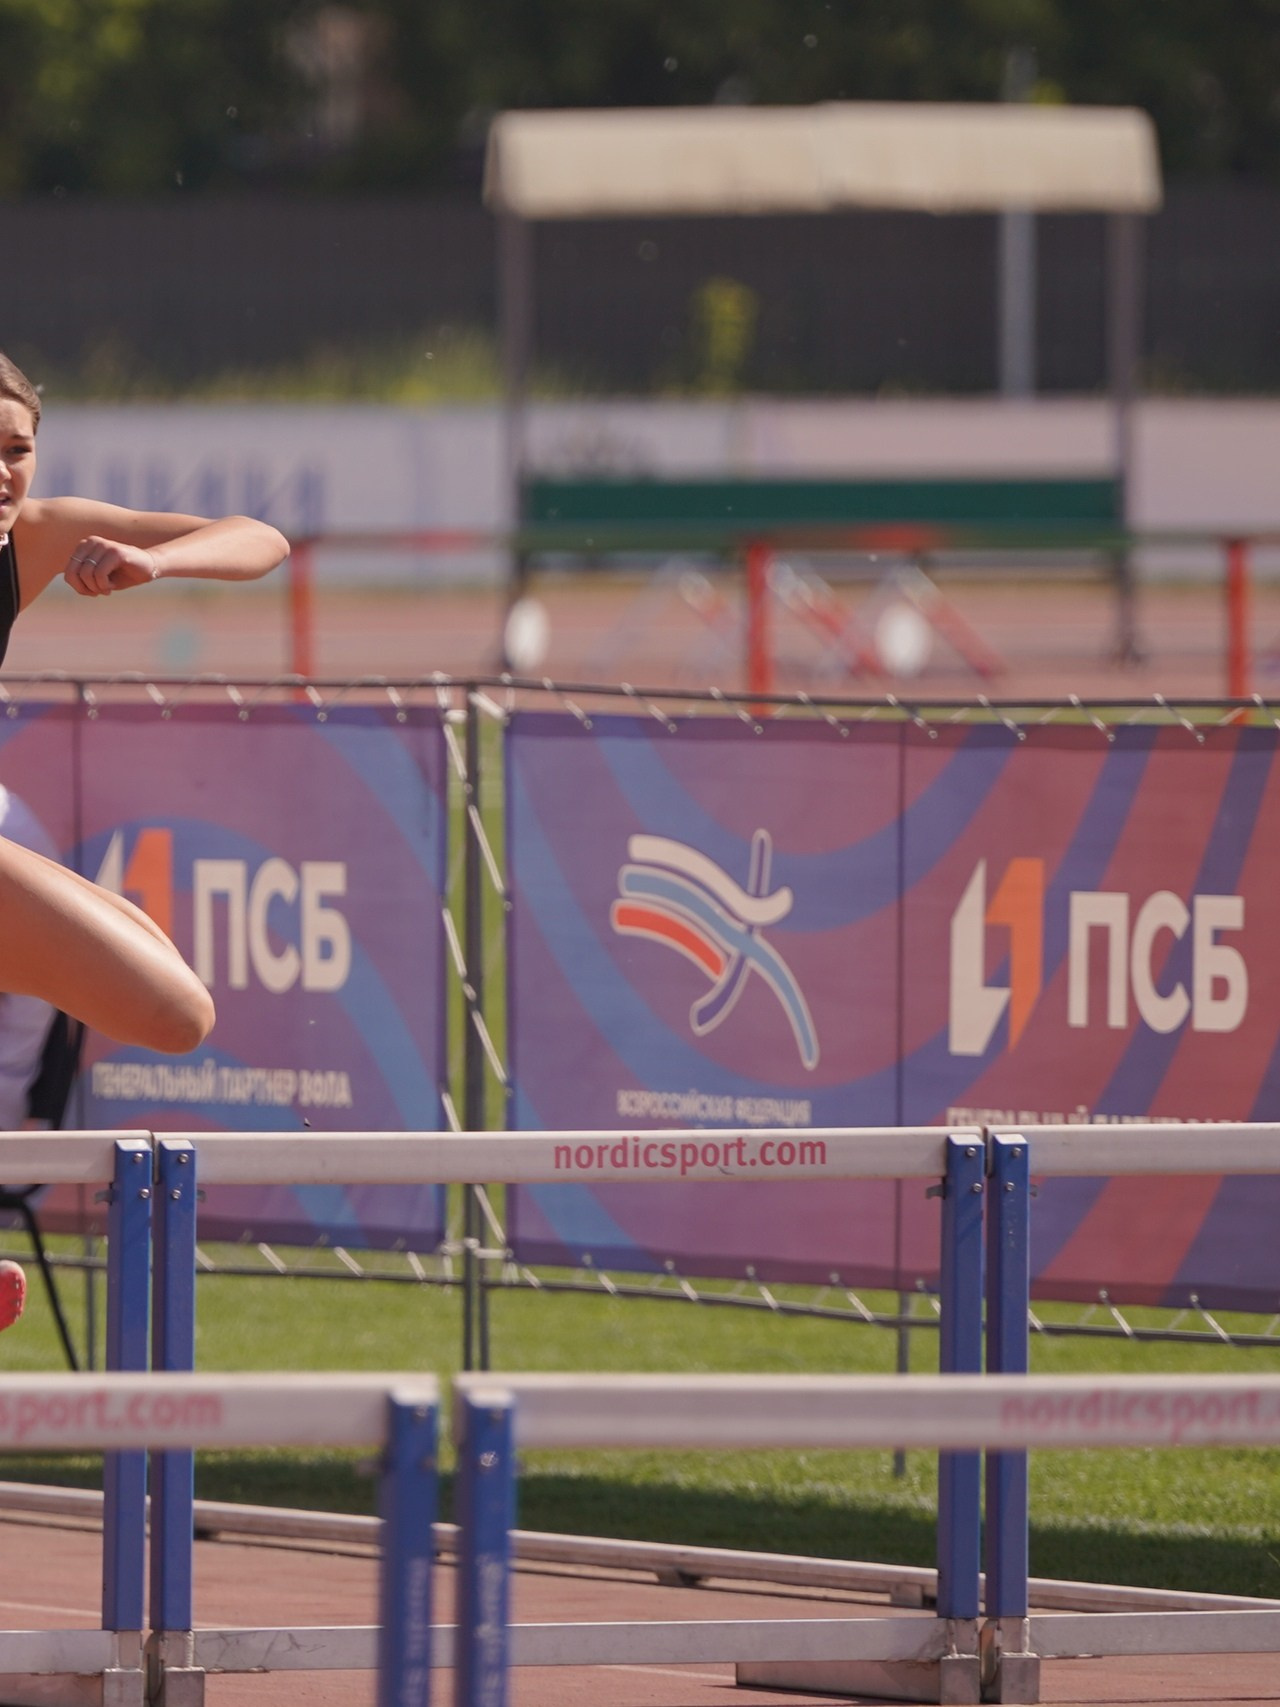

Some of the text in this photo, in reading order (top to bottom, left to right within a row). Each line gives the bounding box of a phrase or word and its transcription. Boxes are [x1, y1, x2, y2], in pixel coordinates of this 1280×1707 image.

[193, 856, 352, 994] ПСБ
[1067, 889, 1249, 1034] ПСБ
[91, 1058, 216, 1101] ГЕНЕРАЛЬНЫЙ
[220, 1066, 298, 1105] ПАРТНЕР
[553, 1136, 827, 1176] nordicsport.com
[1000, 1388, 1280, 1443] nordicsport.
